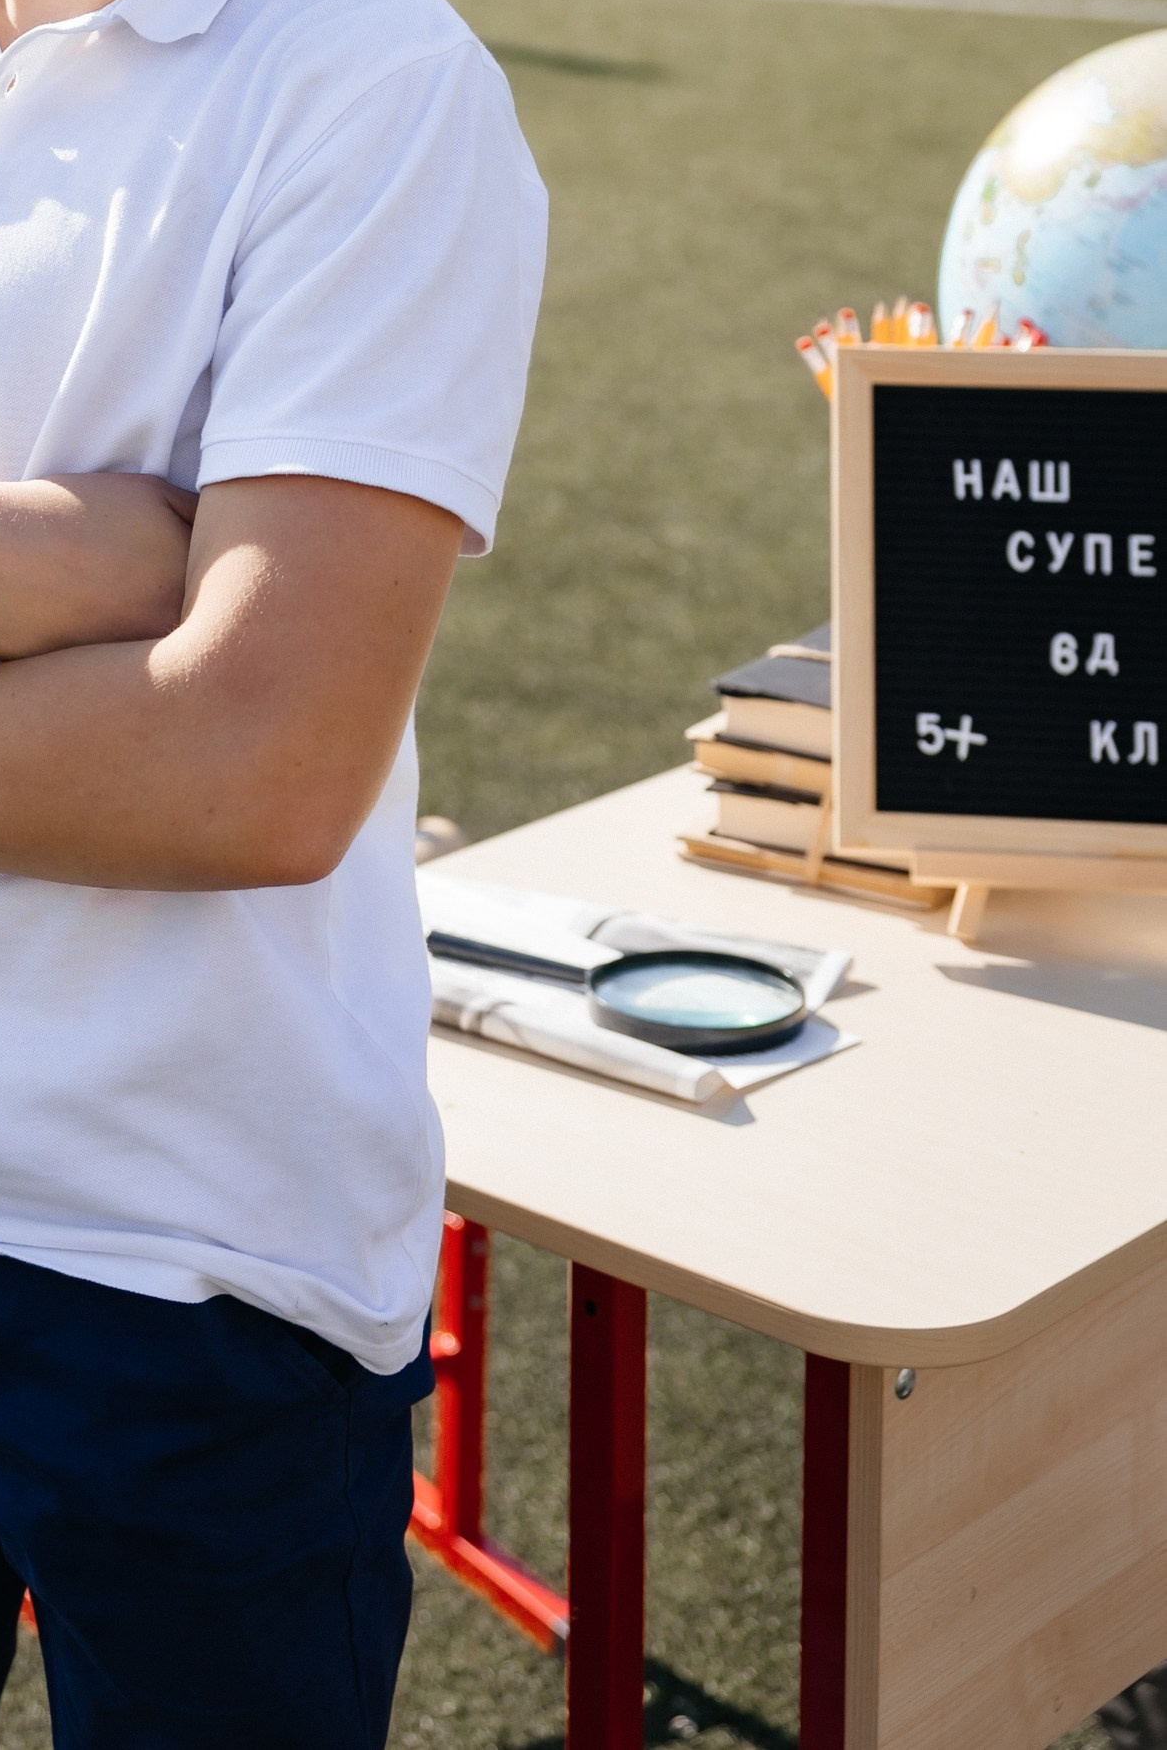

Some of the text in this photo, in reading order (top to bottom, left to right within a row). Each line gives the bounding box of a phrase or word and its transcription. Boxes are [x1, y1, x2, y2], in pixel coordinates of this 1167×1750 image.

[953, 458, 1071, 503] НАШ
[1006, 530, 1157, 577] СУПЕ
[1050, 632, 1119, 676] 6Д
[916, 712, 988, 761] 5+
[1090, 720, 1159, 765] КЛ
